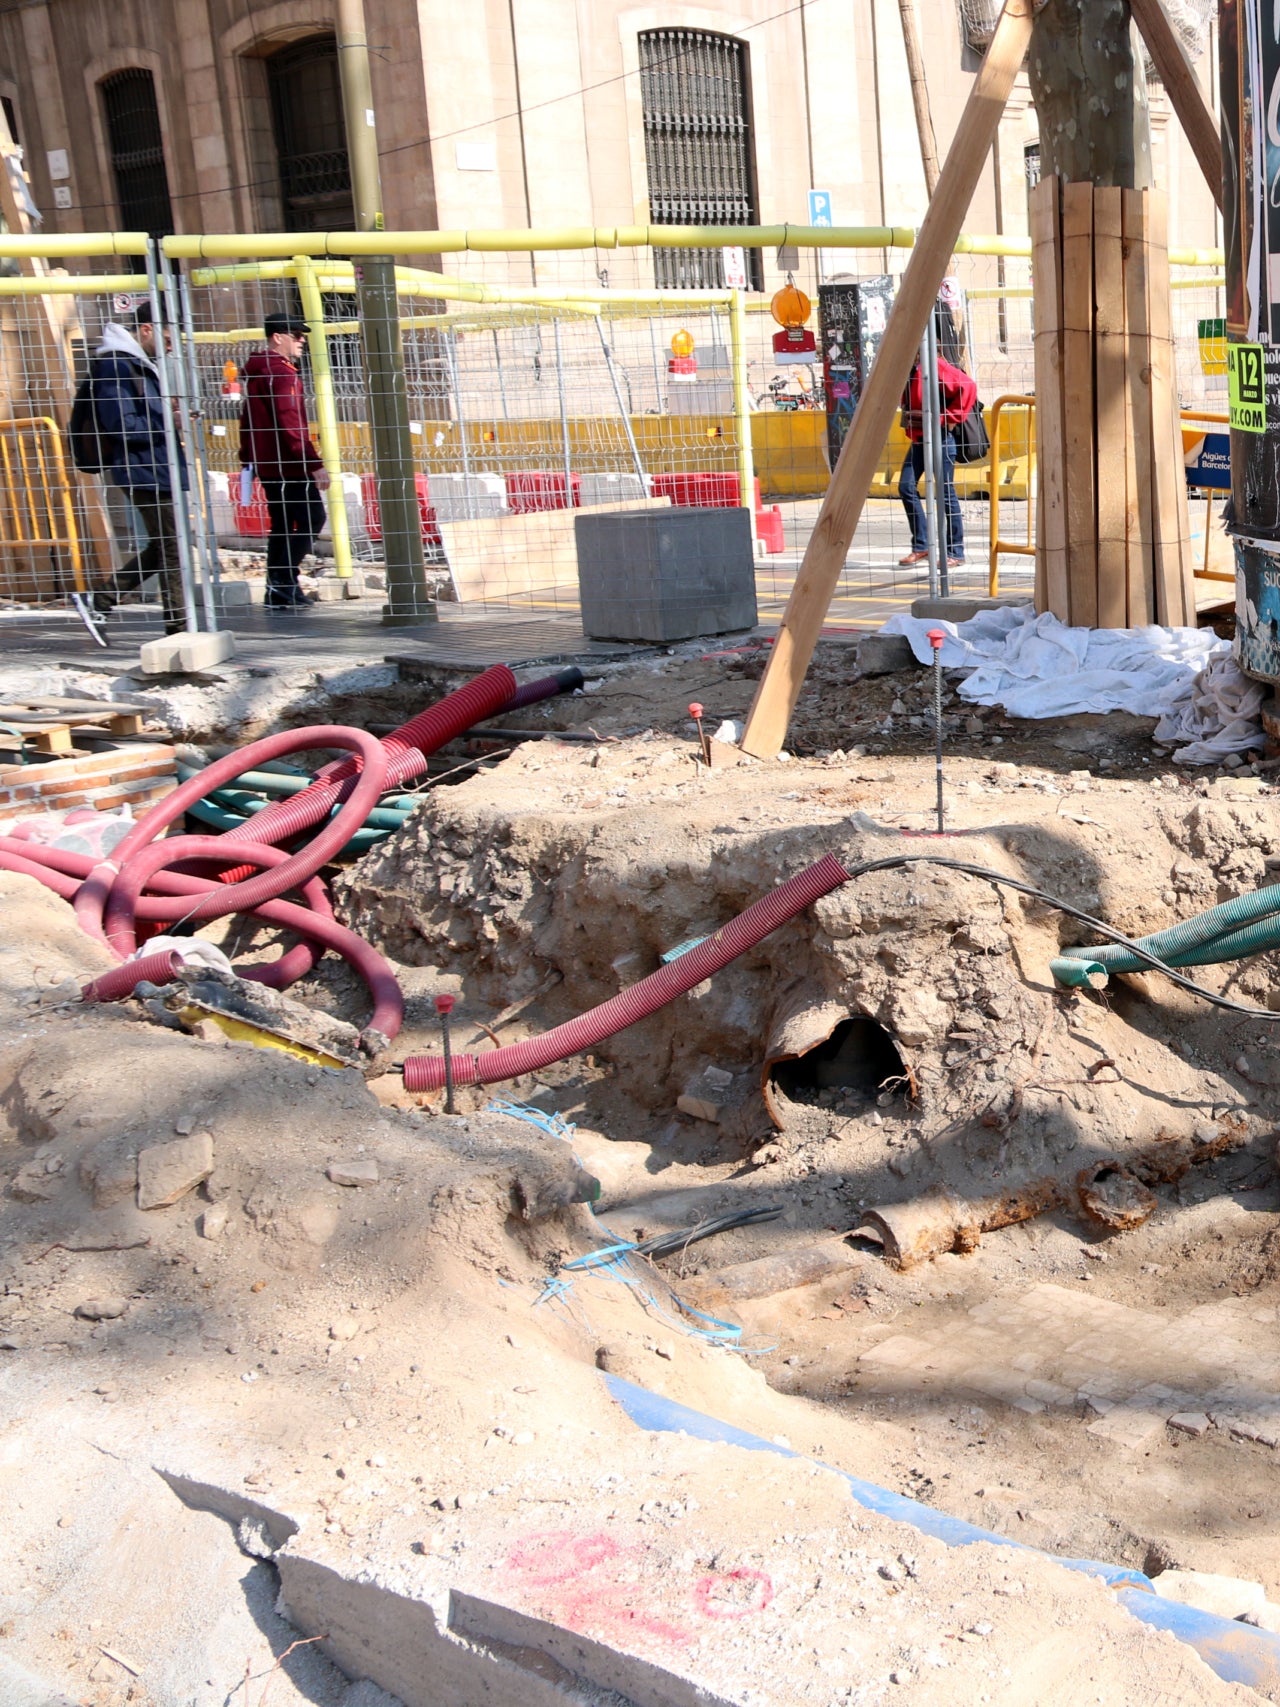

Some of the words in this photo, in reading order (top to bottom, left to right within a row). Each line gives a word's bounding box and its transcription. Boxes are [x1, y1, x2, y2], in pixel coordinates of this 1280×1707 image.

[814, 195, 826, 213] P
[1240, 351, 1258, 387] 12
[1201, 451, 1227, 466] Aigües
